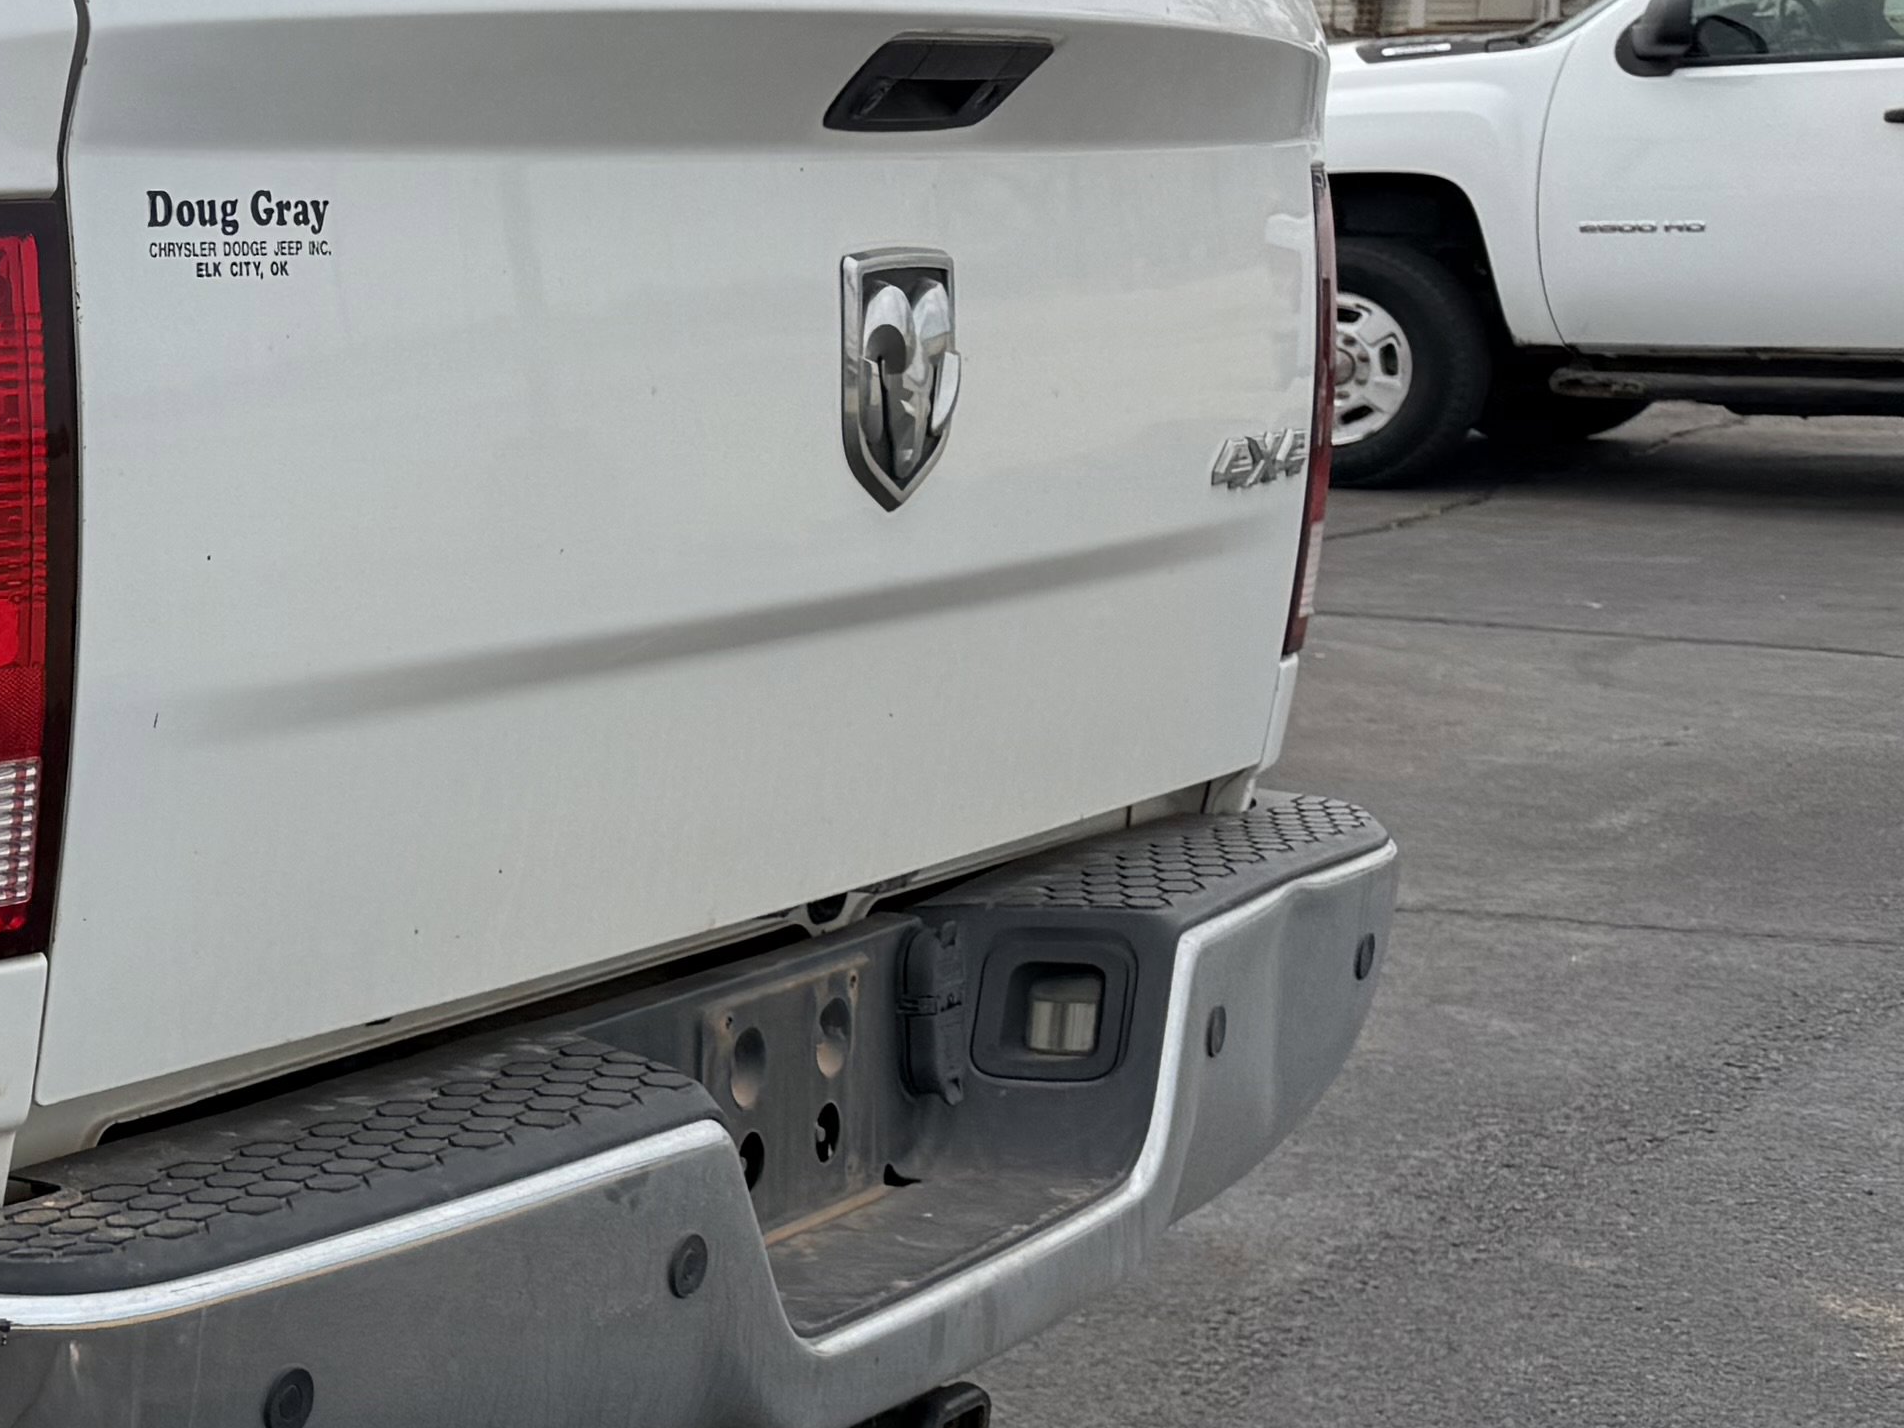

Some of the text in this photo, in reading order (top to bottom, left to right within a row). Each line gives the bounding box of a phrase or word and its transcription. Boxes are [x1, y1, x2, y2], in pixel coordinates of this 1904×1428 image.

[146, 189, 330, 236] Doug Gray
[149, 240, 332, 258] CHRYSLER DODGE JEEP INC.
[196, 260, 289, 280] ELK CITY, OK
